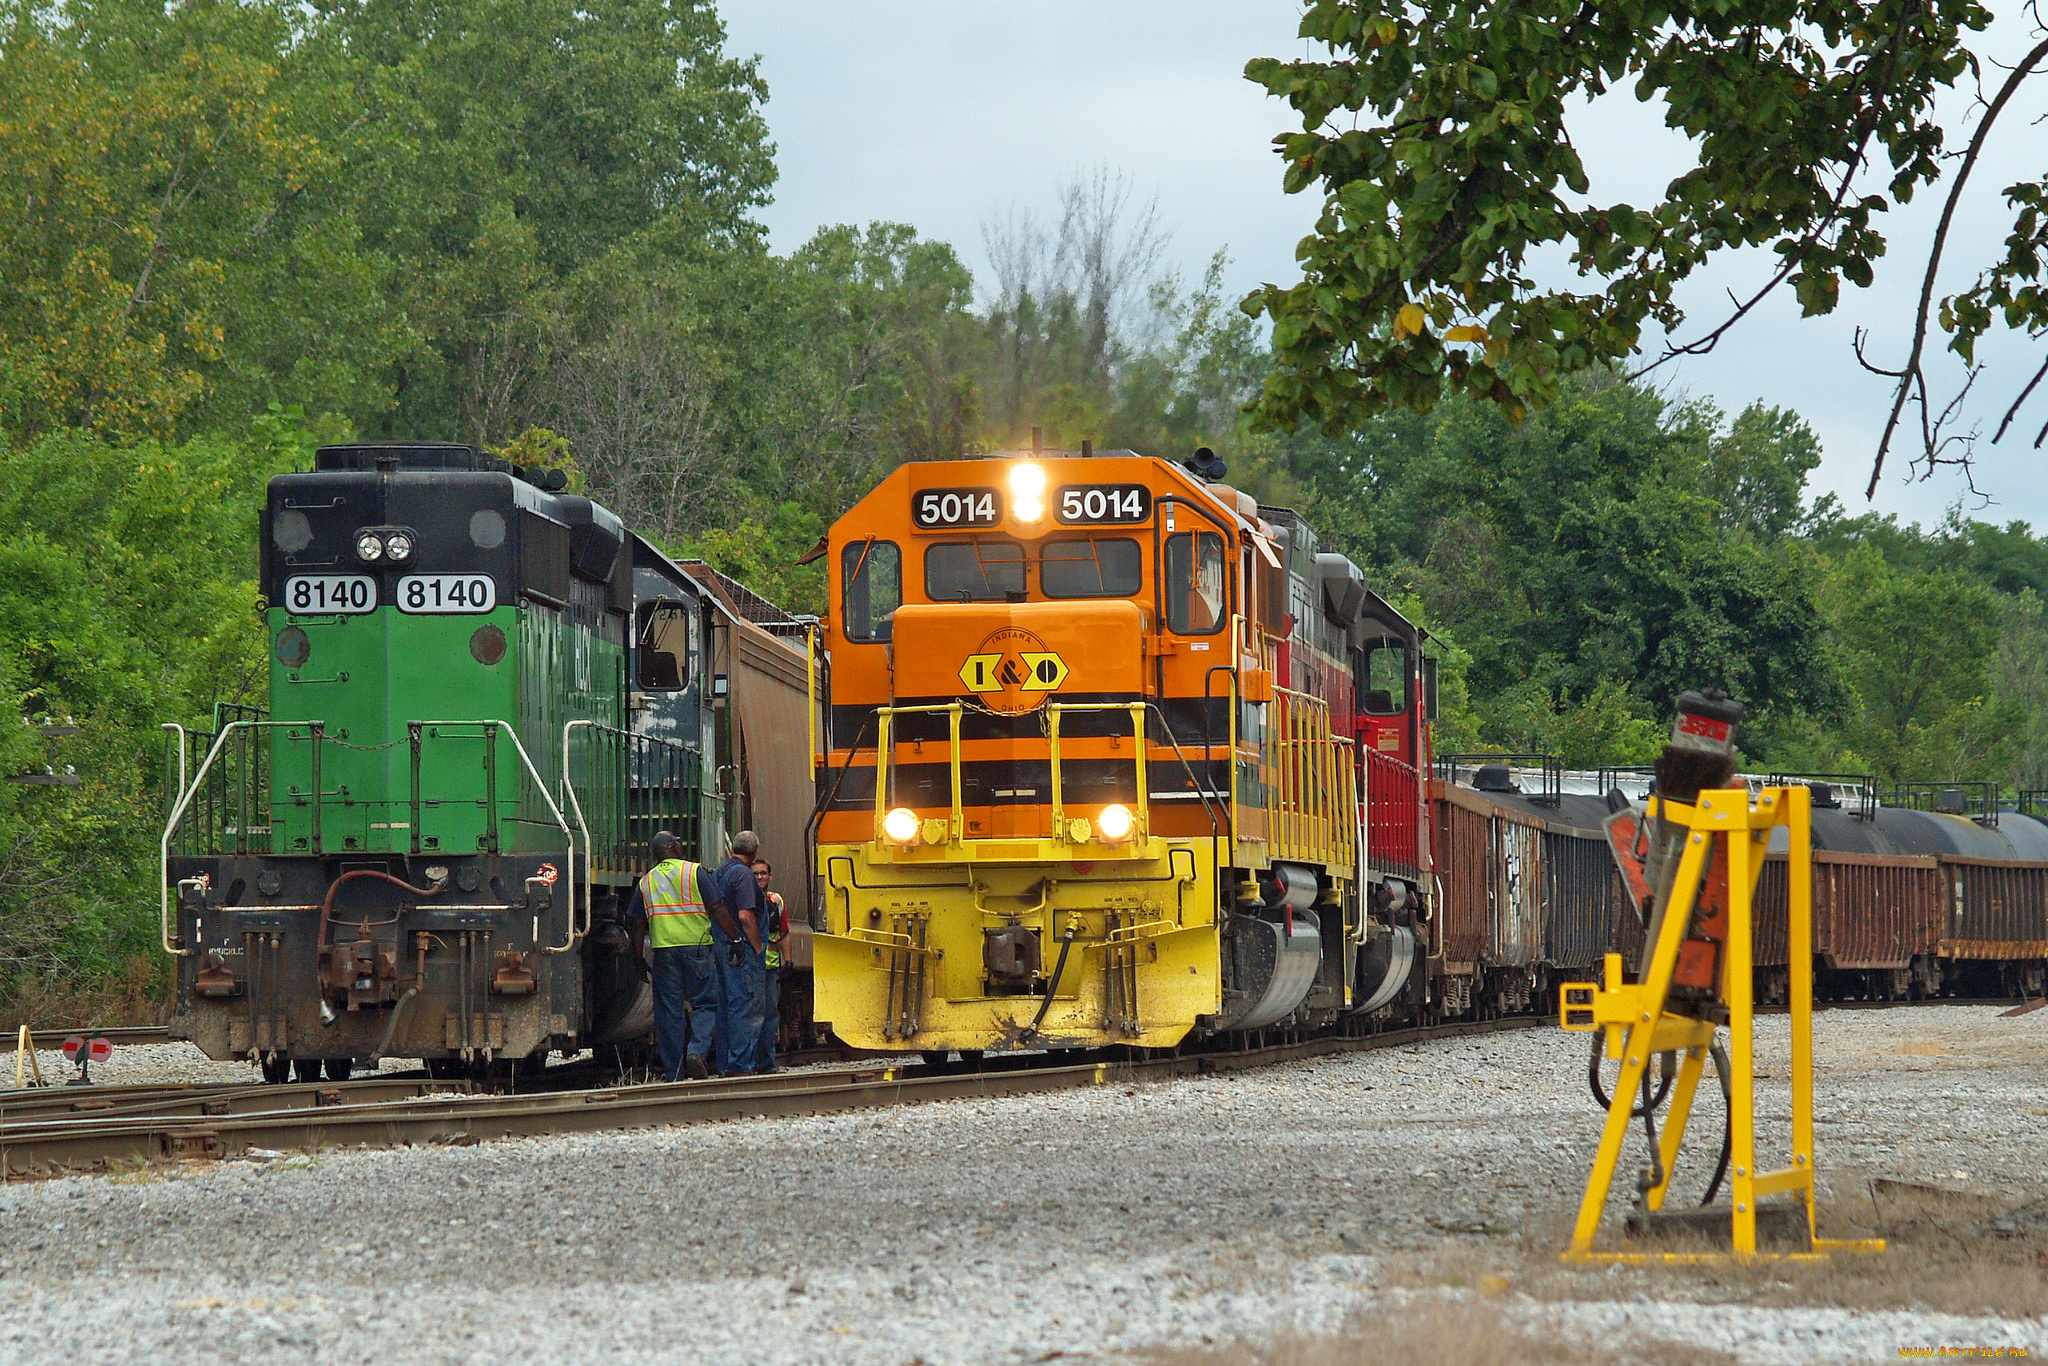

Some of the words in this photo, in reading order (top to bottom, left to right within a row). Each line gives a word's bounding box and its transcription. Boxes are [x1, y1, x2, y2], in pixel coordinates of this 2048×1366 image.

[921, 493, 995, 523] 5014
[1062, 489, 1142, 519] 5014
[293, 580, 368, 608] 8140
[407, 579, 487, 608] 8140
[991, 631, 1031, 644] INDIANA
[976, 661, 984, 685] I
[1001, 659, 1022, 685] &
[1036, 659, 1058, 684] O
[1001, 704, 1025, 712] OHIO
